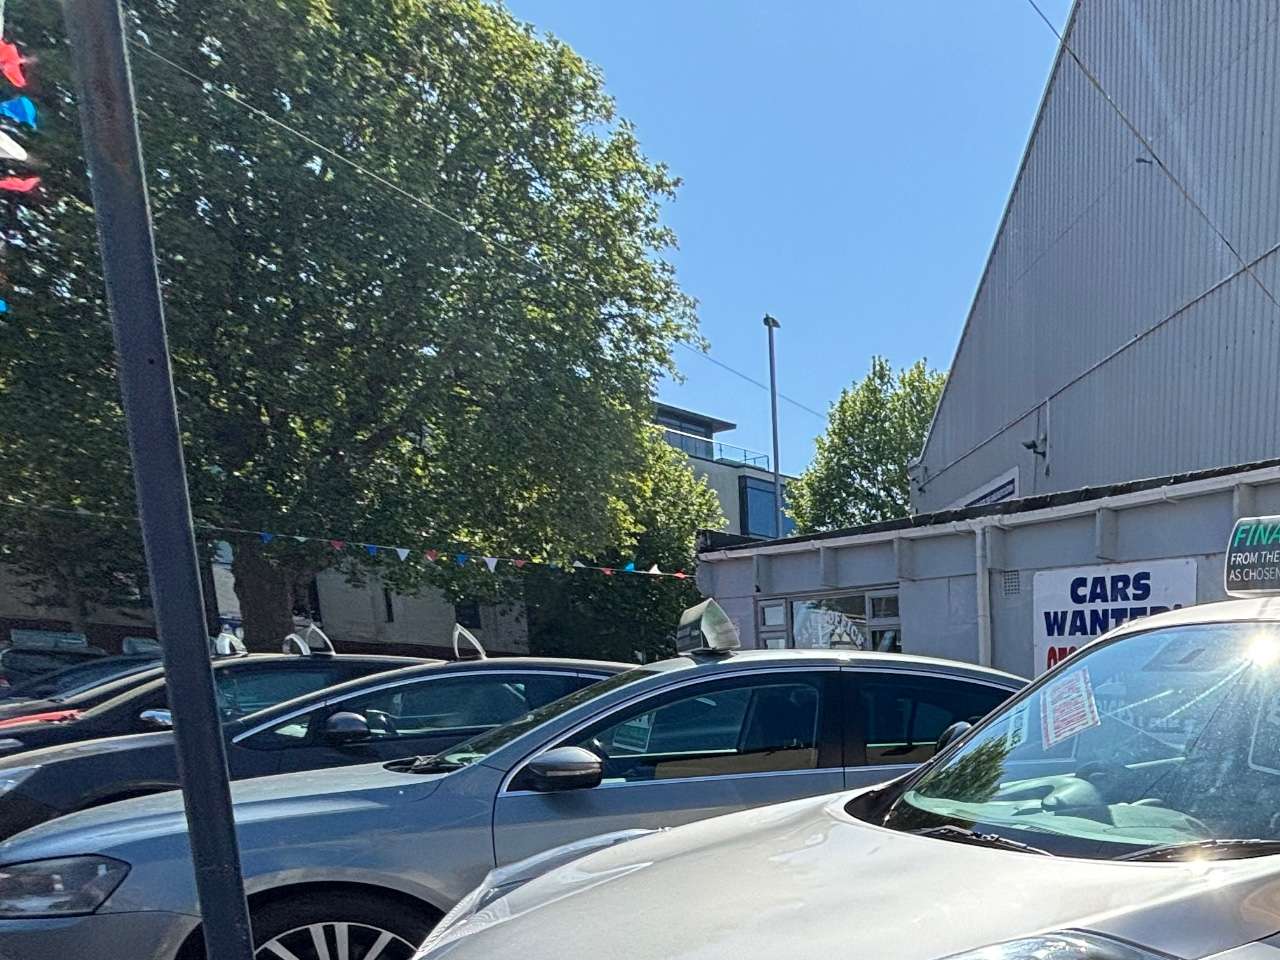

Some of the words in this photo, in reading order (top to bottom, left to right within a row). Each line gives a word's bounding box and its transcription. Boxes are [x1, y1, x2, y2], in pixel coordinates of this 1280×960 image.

[1230, 551, 1258, 566] FROM
[1261, 550, 1280, 563] THE
[1229, 568, 1241, 581] AS
[1070, 571, 1151, 604] CARS
